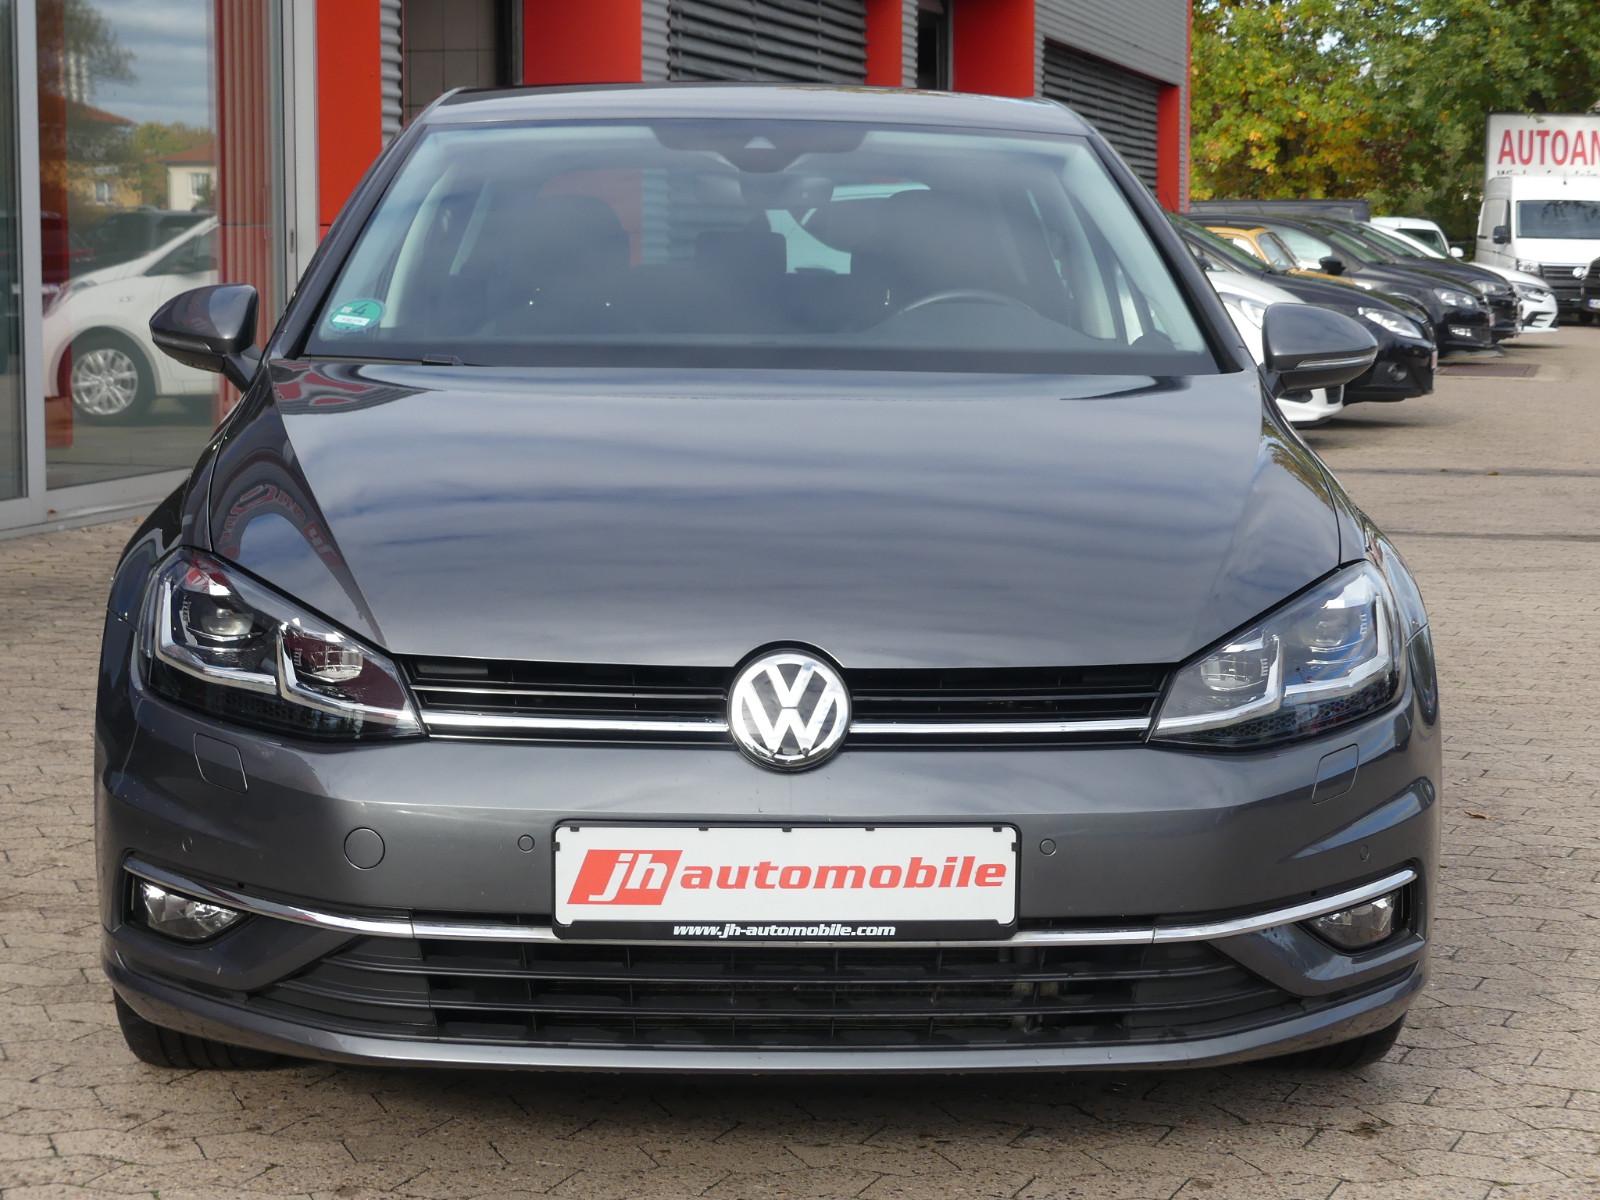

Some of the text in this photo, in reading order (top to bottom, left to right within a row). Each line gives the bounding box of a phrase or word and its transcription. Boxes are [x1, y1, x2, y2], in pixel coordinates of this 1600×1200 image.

[351, 303, 369, 315] 4
[733, 656, 846, 764] VW
[587, 852, 1007, 902] jh automobile
[673, 923, 896, 939] www.jh-automobile.com
